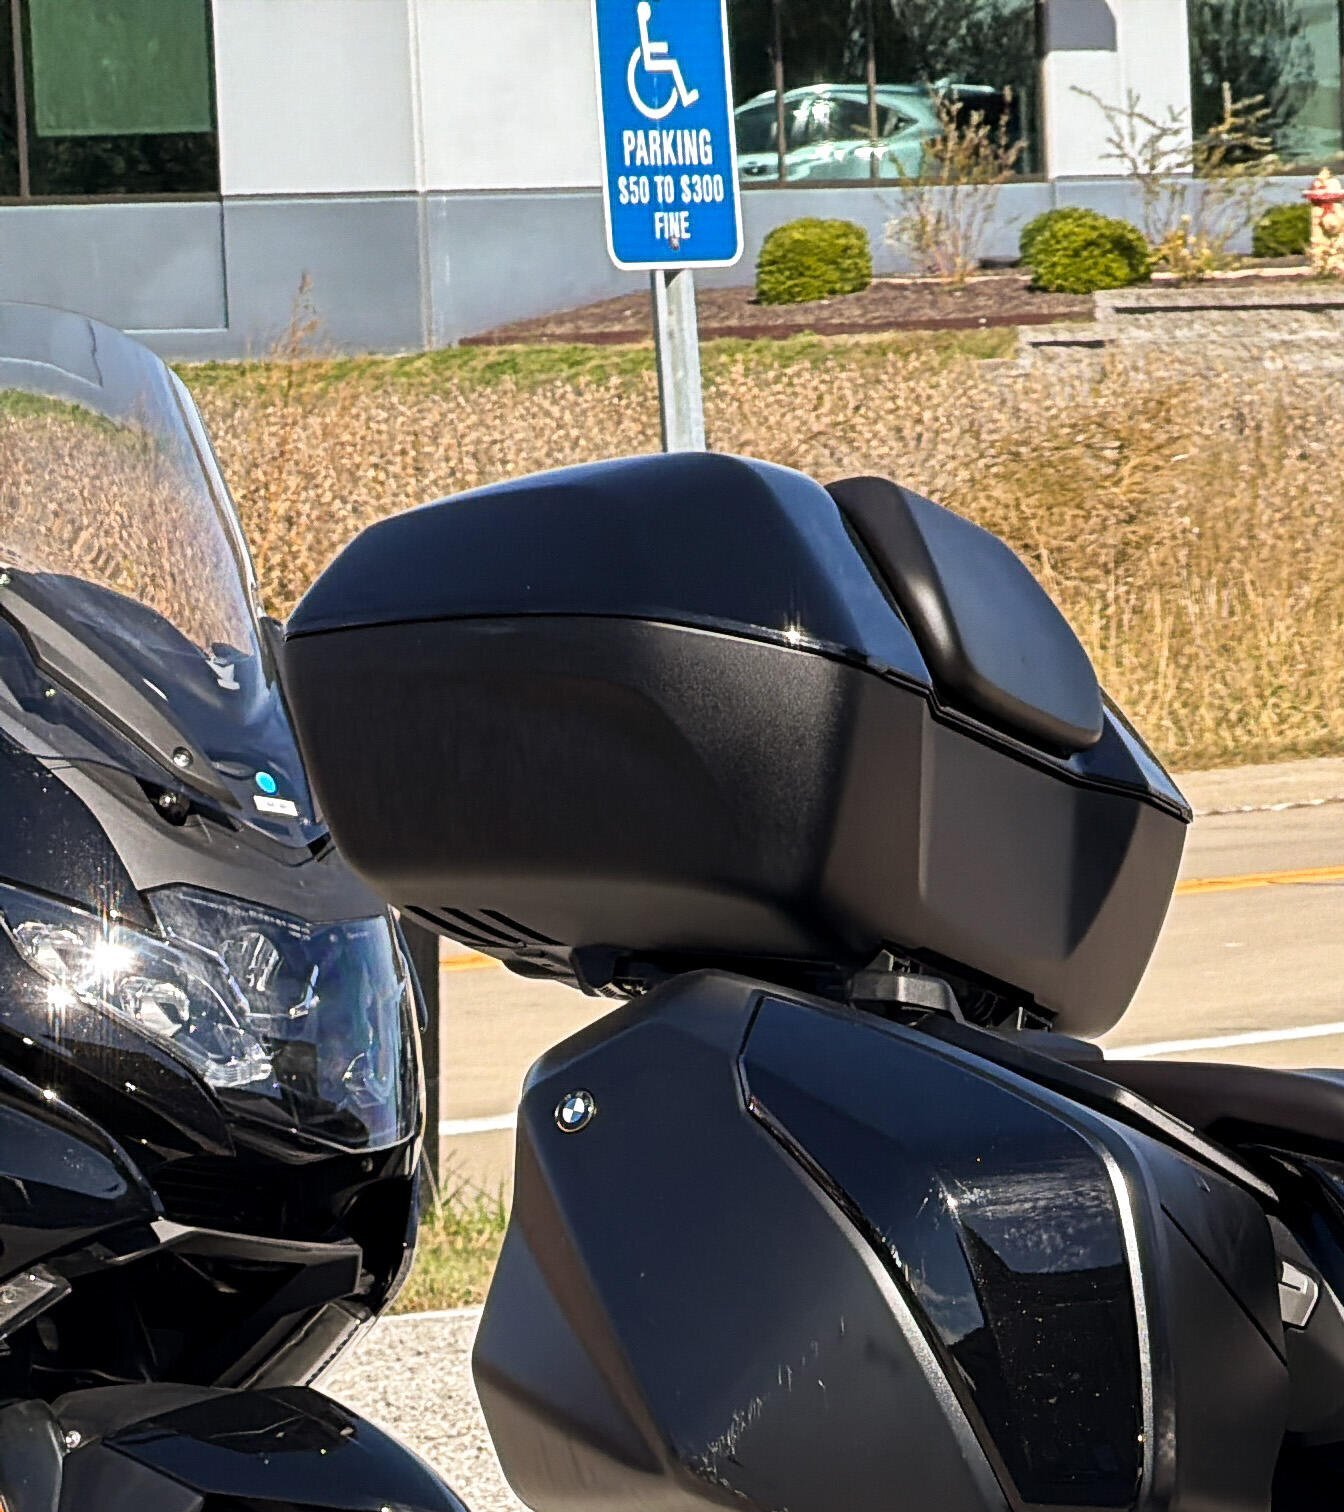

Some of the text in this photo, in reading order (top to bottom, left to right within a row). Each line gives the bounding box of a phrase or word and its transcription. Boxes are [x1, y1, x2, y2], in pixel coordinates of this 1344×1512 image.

[622, 128, 714, 167] PARKING
[618, 173, 724, 205] $50 TO $300
[654, 210, 691, 240] FINE
